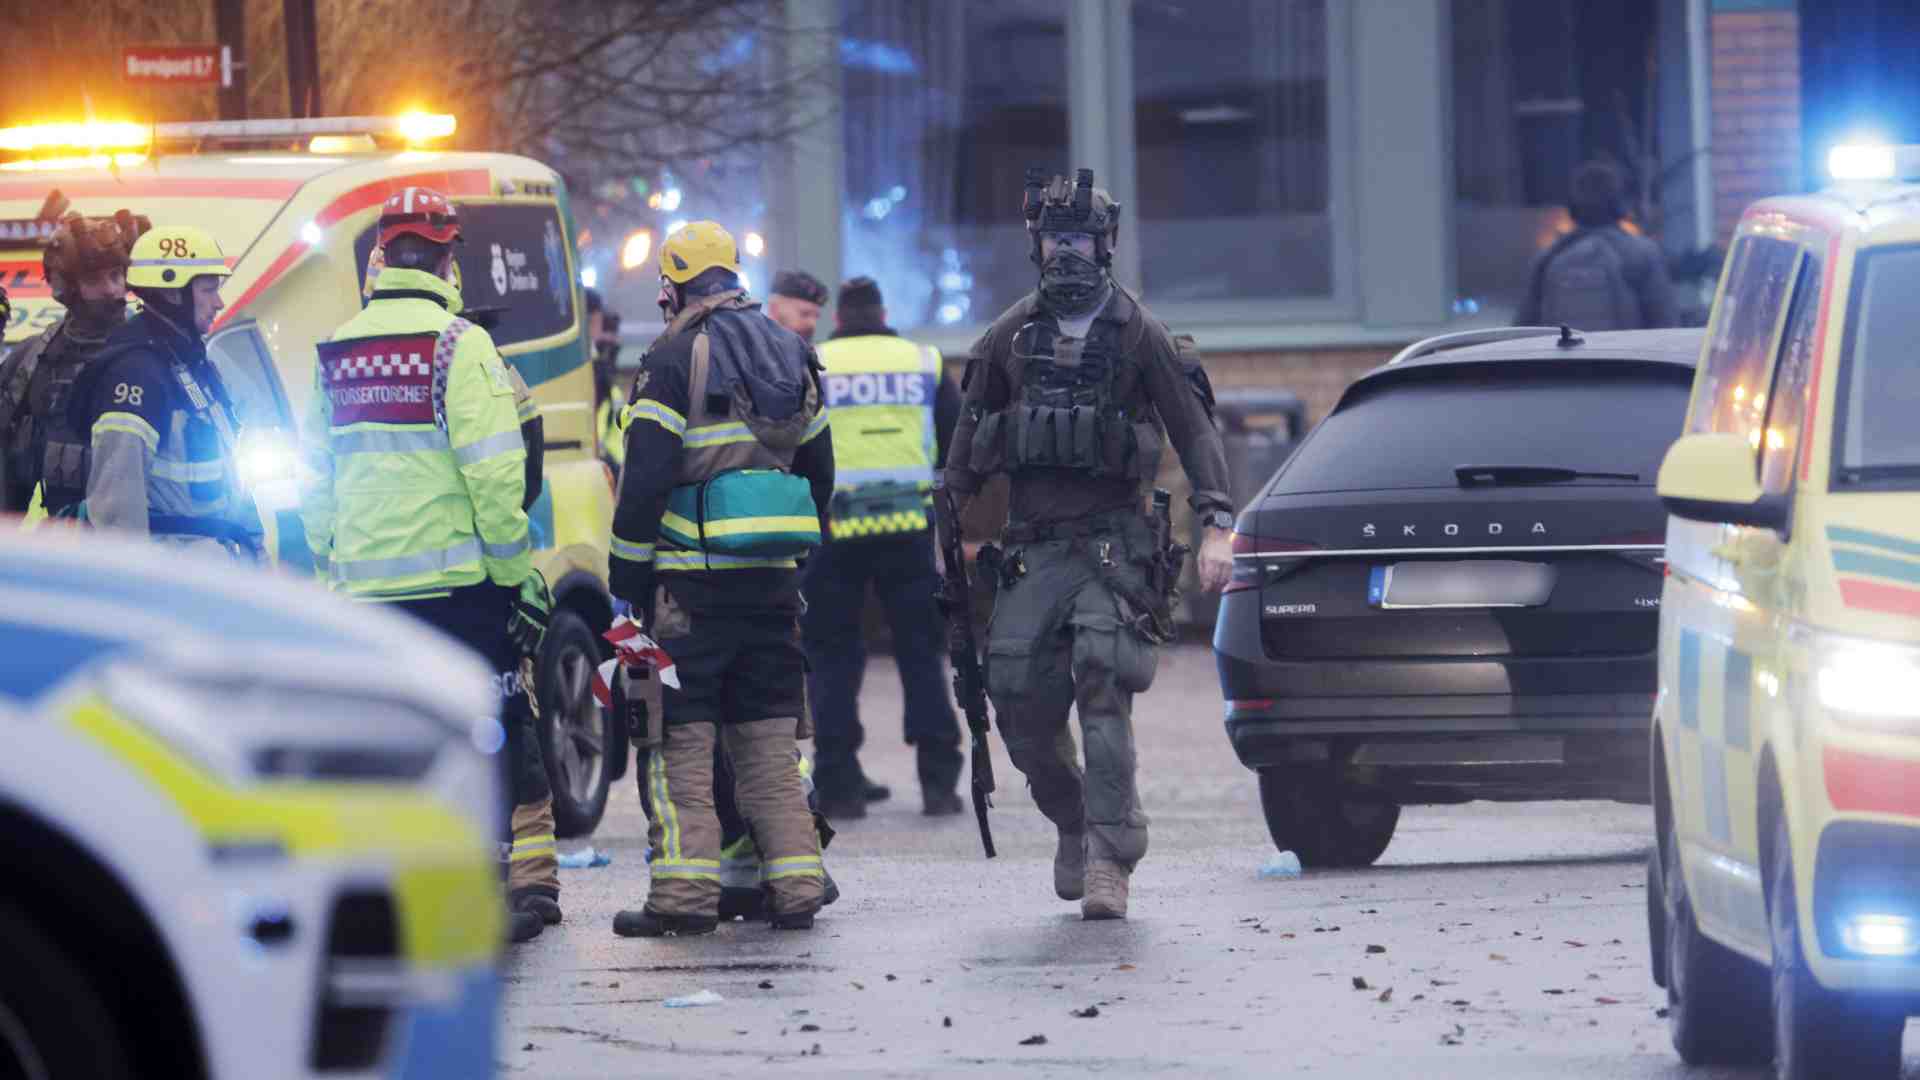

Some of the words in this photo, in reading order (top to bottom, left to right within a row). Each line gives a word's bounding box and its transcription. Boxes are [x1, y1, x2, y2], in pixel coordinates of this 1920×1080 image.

[113, 382, 144, 406] 98
[828, 373, 925, 405] POLIS
[1264, 604, 1317, 615] SUPERB
